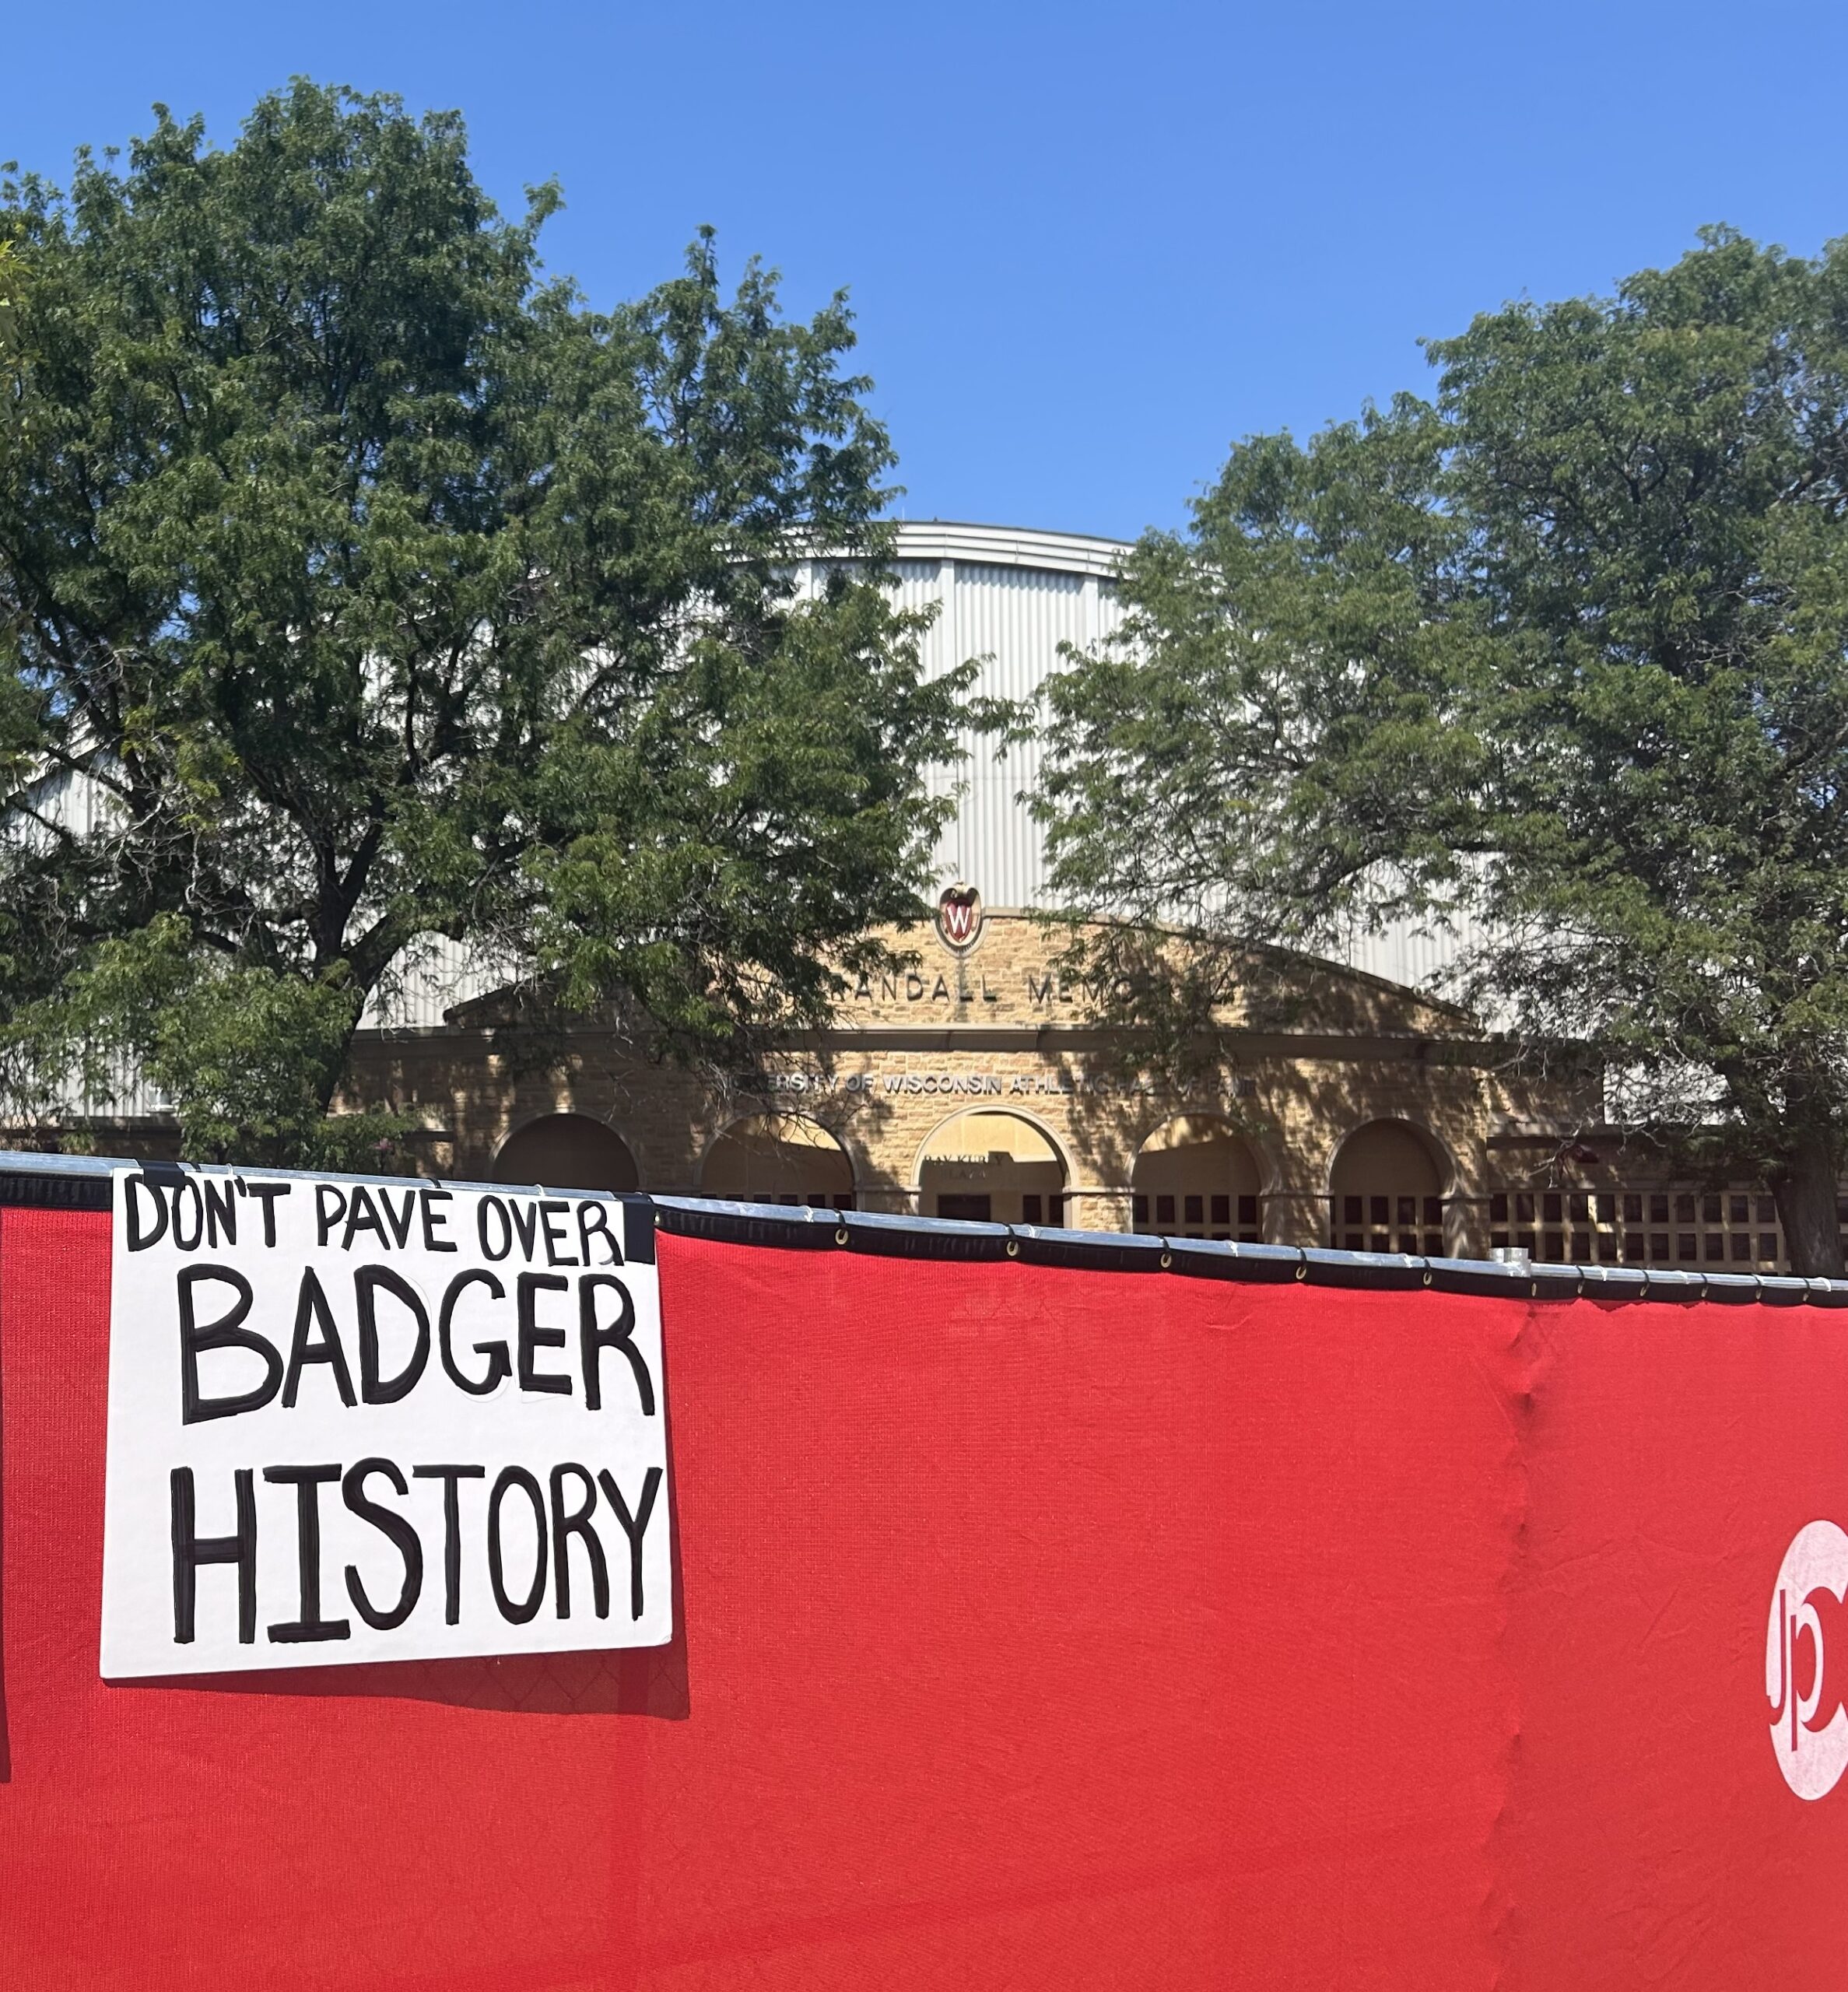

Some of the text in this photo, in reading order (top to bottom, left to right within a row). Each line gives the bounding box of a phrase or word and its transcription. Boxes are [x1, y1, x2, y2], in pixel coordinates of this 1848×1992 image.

[946, 905, 971, 935] W
[845, 1073, 874, 1093] OF
[882, 1074, 1002, 1096] WISCONSIN
[125, 1174, 626, 1267] DON'T PAVE OVER
[177, 1263, 656, 1426] BADGER
[170, 1457, 664, 1645] HISTORY
